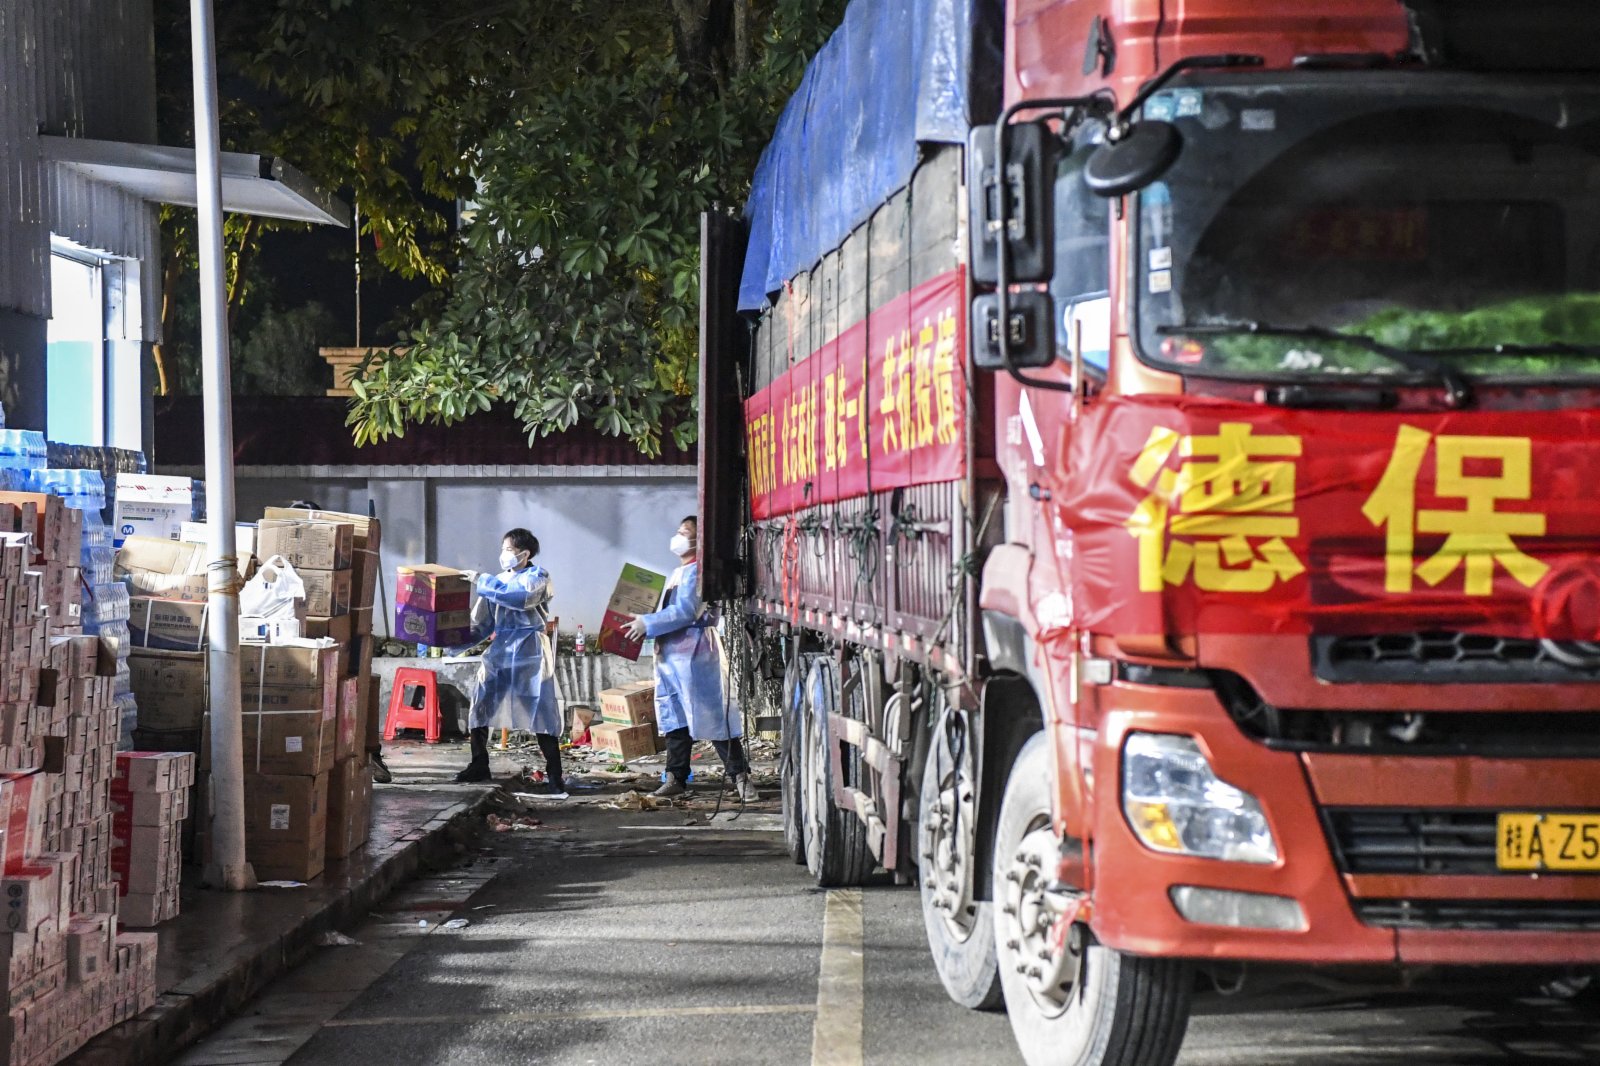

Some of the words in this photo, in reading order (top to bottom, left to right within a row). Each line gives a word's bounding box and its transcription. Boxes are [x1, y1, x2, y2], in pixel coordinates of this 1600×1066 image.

[782, 379, 817, 484] 众志成城
[881, 306, 957, 456] 共抗疫情
[1128, 421, 1551, 596] 德保
